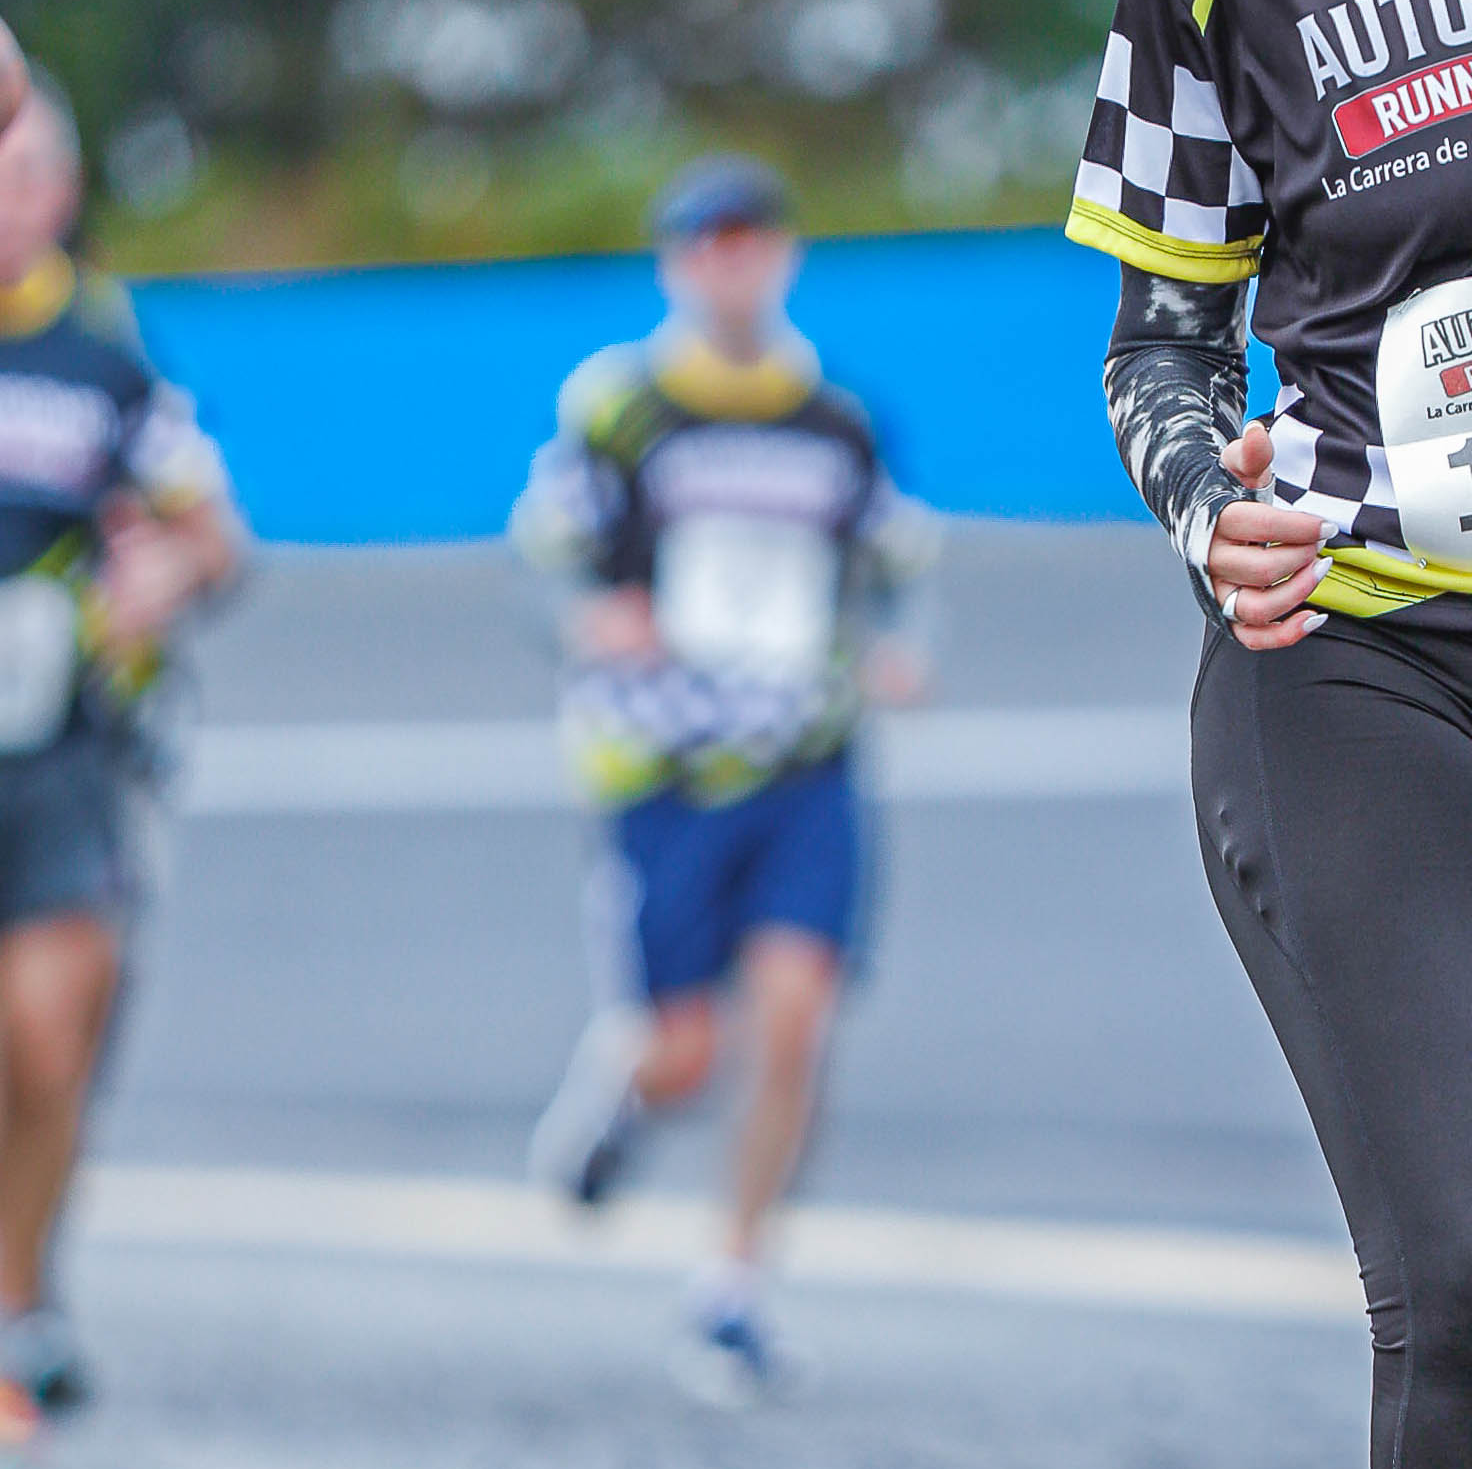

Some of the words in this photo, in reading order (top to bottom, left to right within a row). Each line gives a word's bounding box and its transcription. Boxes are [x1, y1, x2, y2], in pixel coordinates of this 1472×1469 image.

[1321, 175, 1347, 200] La
[1350, 155, 1430, 194] Carrera
[1435, 137, 1469, 164] de
[1427, 406, 1442, 420] La
